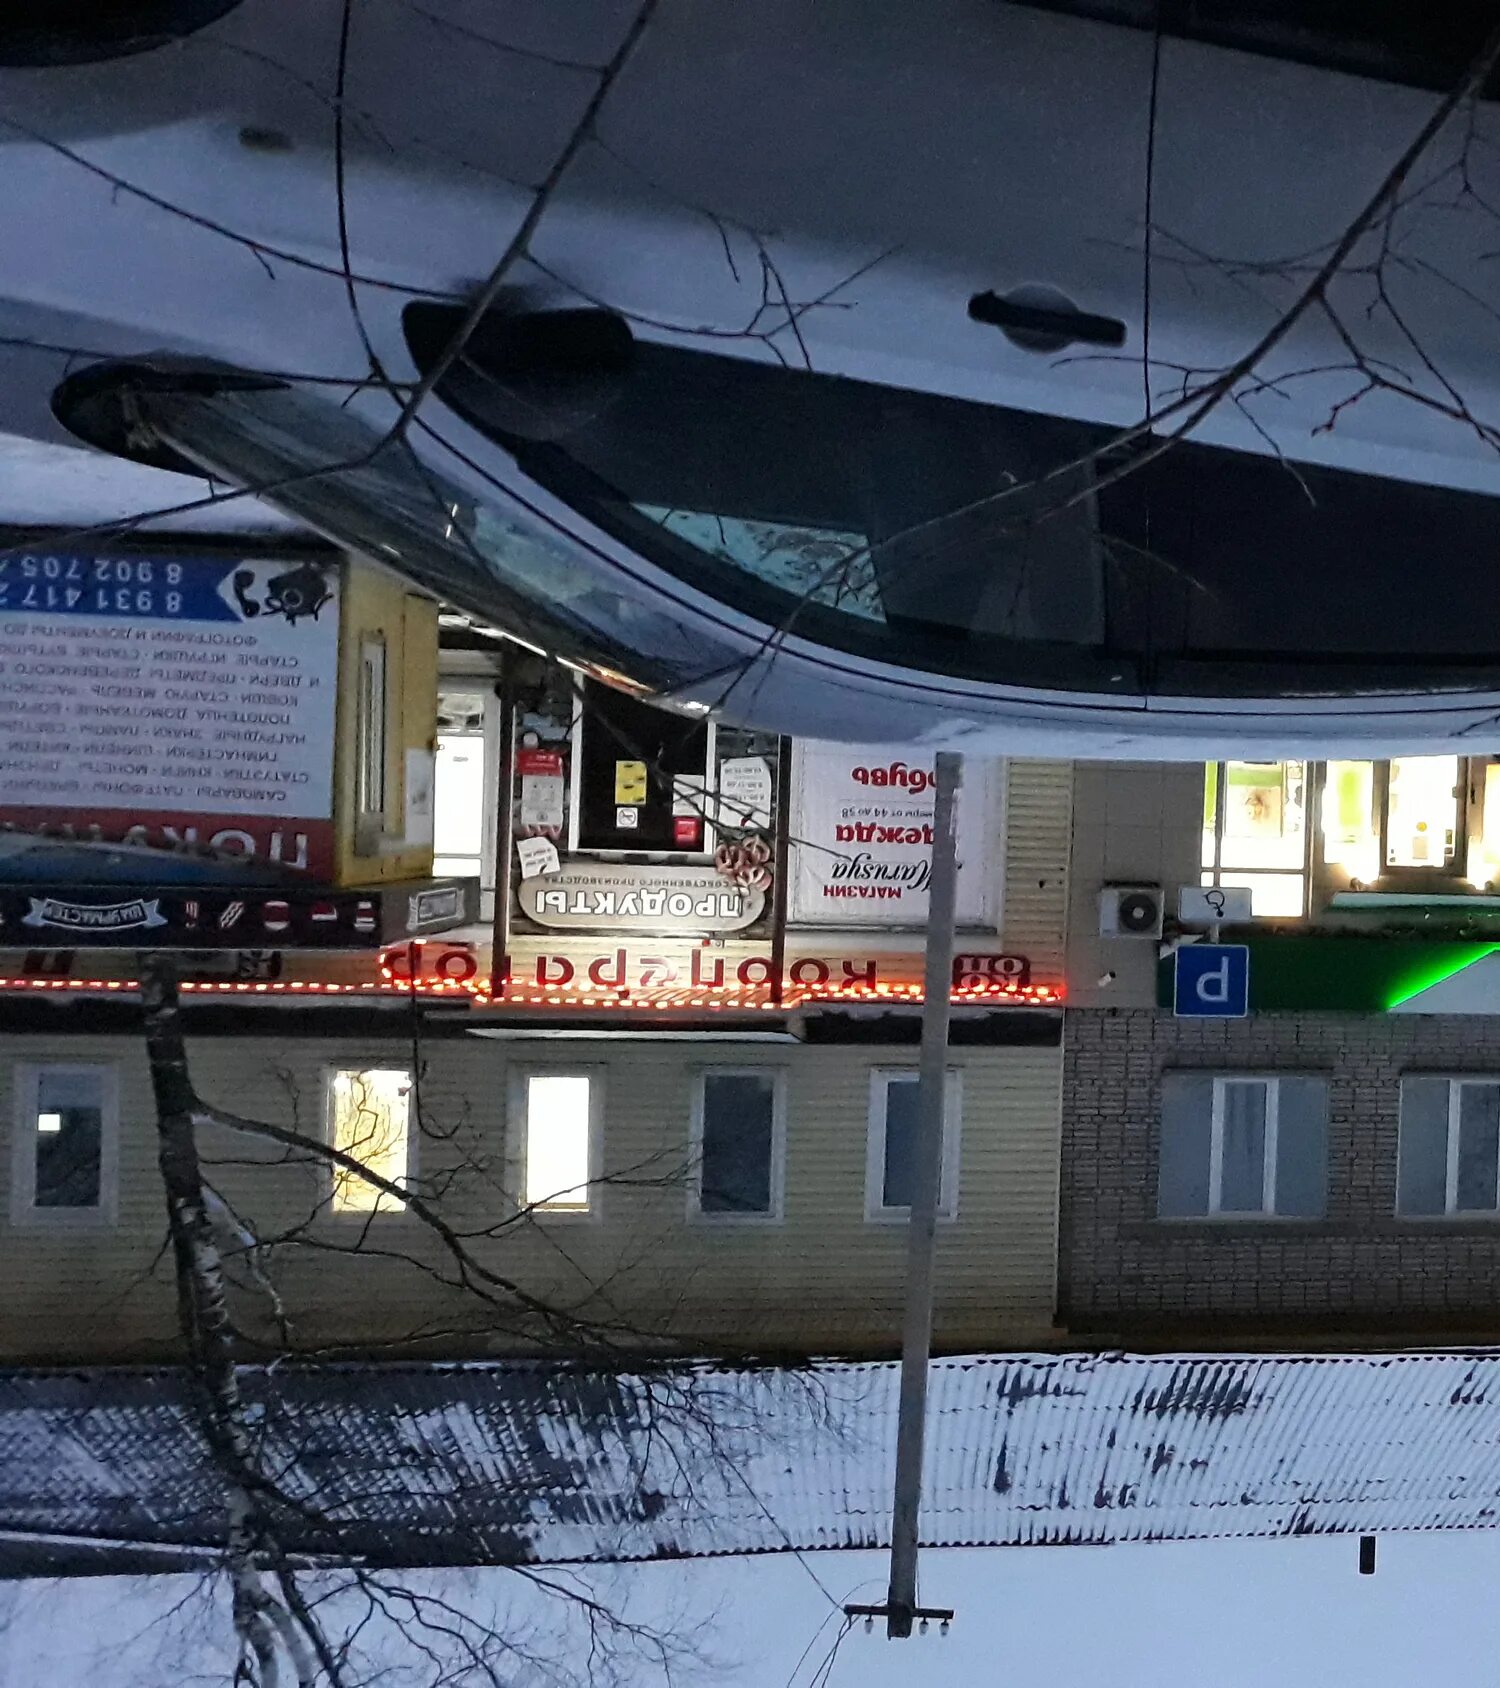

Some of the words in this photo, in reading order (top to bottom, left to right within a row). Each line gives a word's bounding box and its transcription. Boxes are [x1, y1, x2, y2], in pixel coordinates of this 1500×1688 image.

[20, 555, 82, 581] 705
[165, 563, 183, 585] 8
[21, 583, 82, 608] 417
[96, 588, 152, 611] 931
[165, 591, 182, 613] 8
[873, 808, 888, 819] 44
[835, 821, 934, 846] дежда
[535, 888, 740, 918] ПРОДУКТЫ
[822, 884, 902, 900] МАГАЗИН
[1196, 956, 1229, 1002] P
